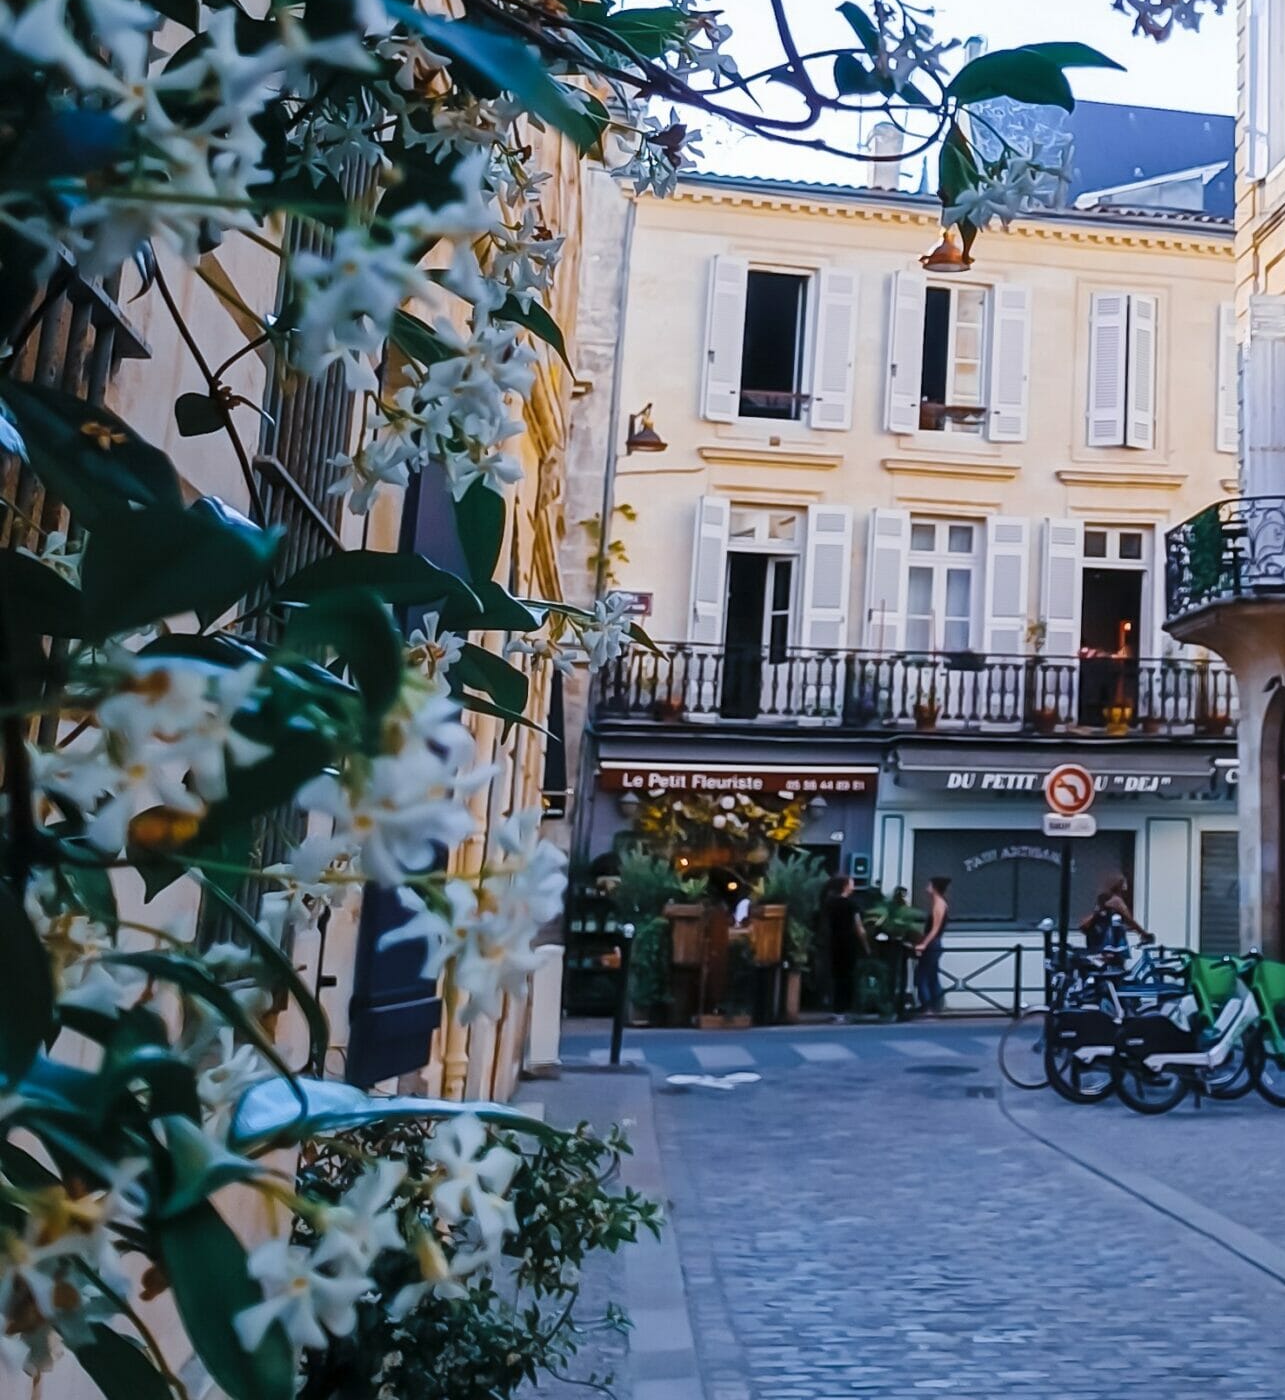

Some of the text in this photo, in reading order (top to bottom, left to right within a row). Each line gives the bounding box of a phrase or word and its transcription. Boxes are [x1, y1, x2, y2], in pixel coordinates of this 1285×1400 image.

[622, 772, 763, 791] Le Petit Fleuriste
[946, 772, 977, 790] DU
[980, 773, 1038, 790] PETIT
